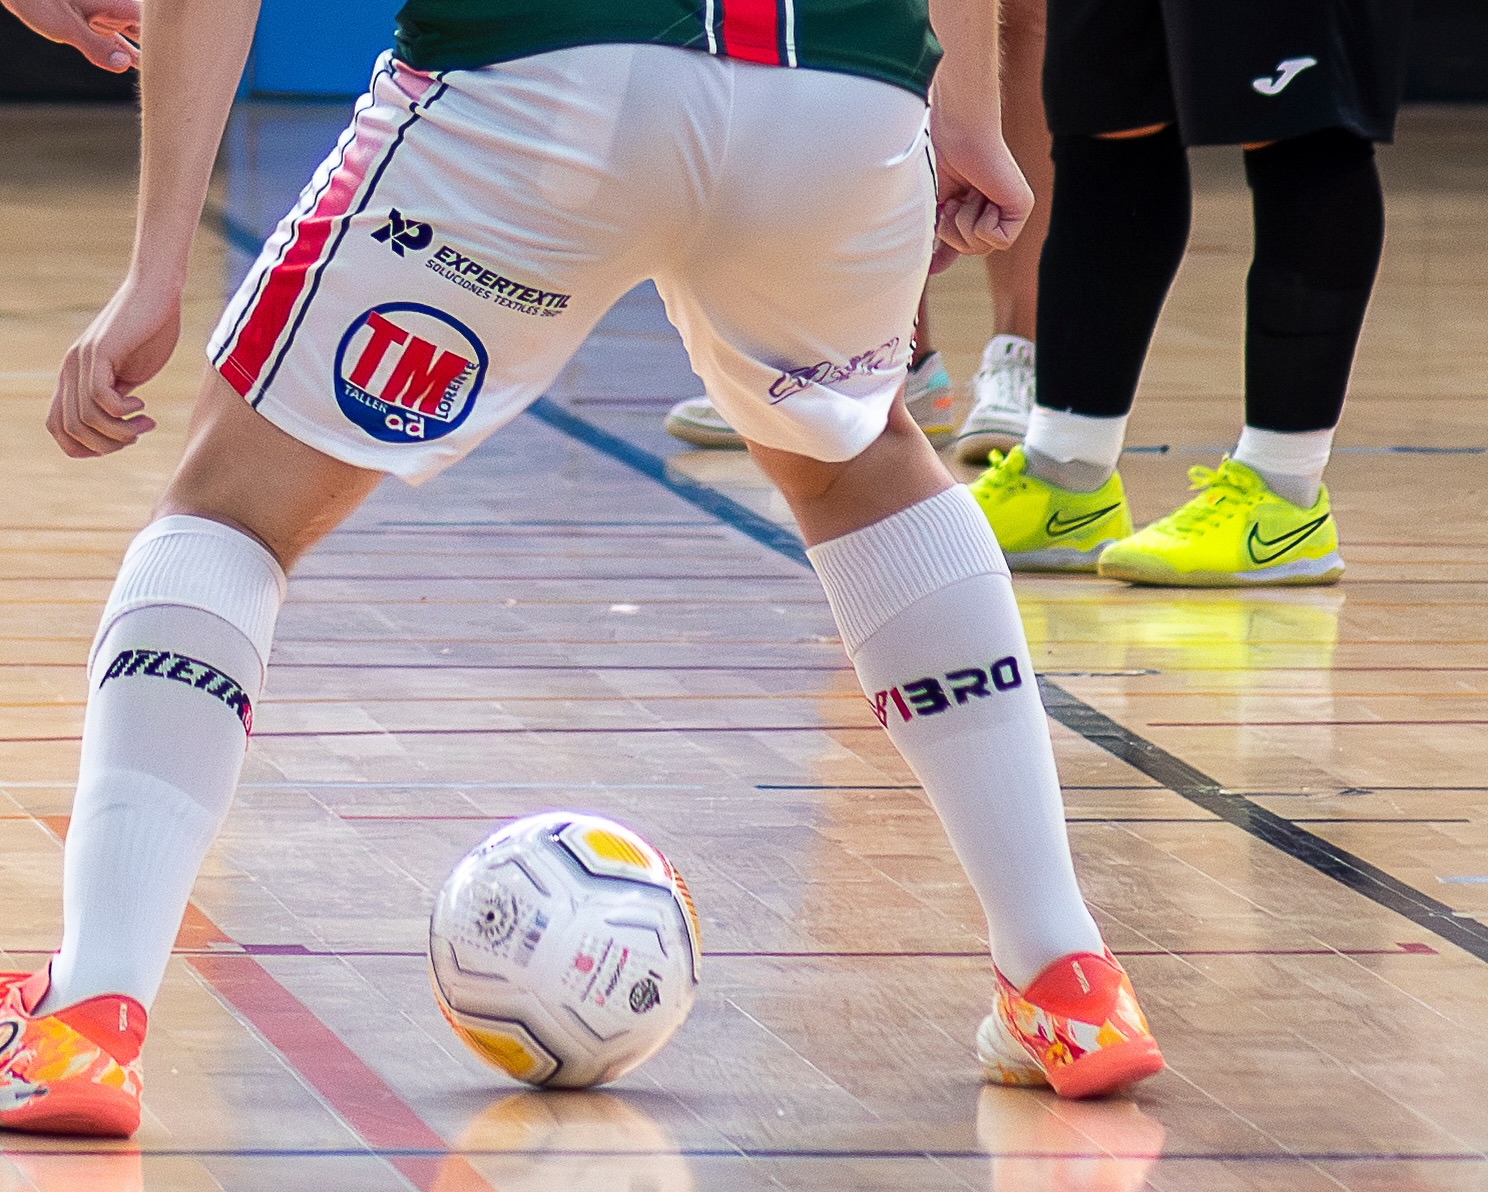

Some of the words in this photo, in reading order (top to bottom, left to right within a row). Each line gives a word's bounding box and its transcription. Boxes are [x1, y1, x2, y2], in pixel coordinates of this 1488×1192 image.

[425, 259, 492, 300] SOLUCIONES
[493, 295, 539, 316] TEXTILES
[433, 245, 572, 309] EXPERTEXTIL
[349, 310, 469, 416] TM
[344, 384, 389, 414] TALLER
